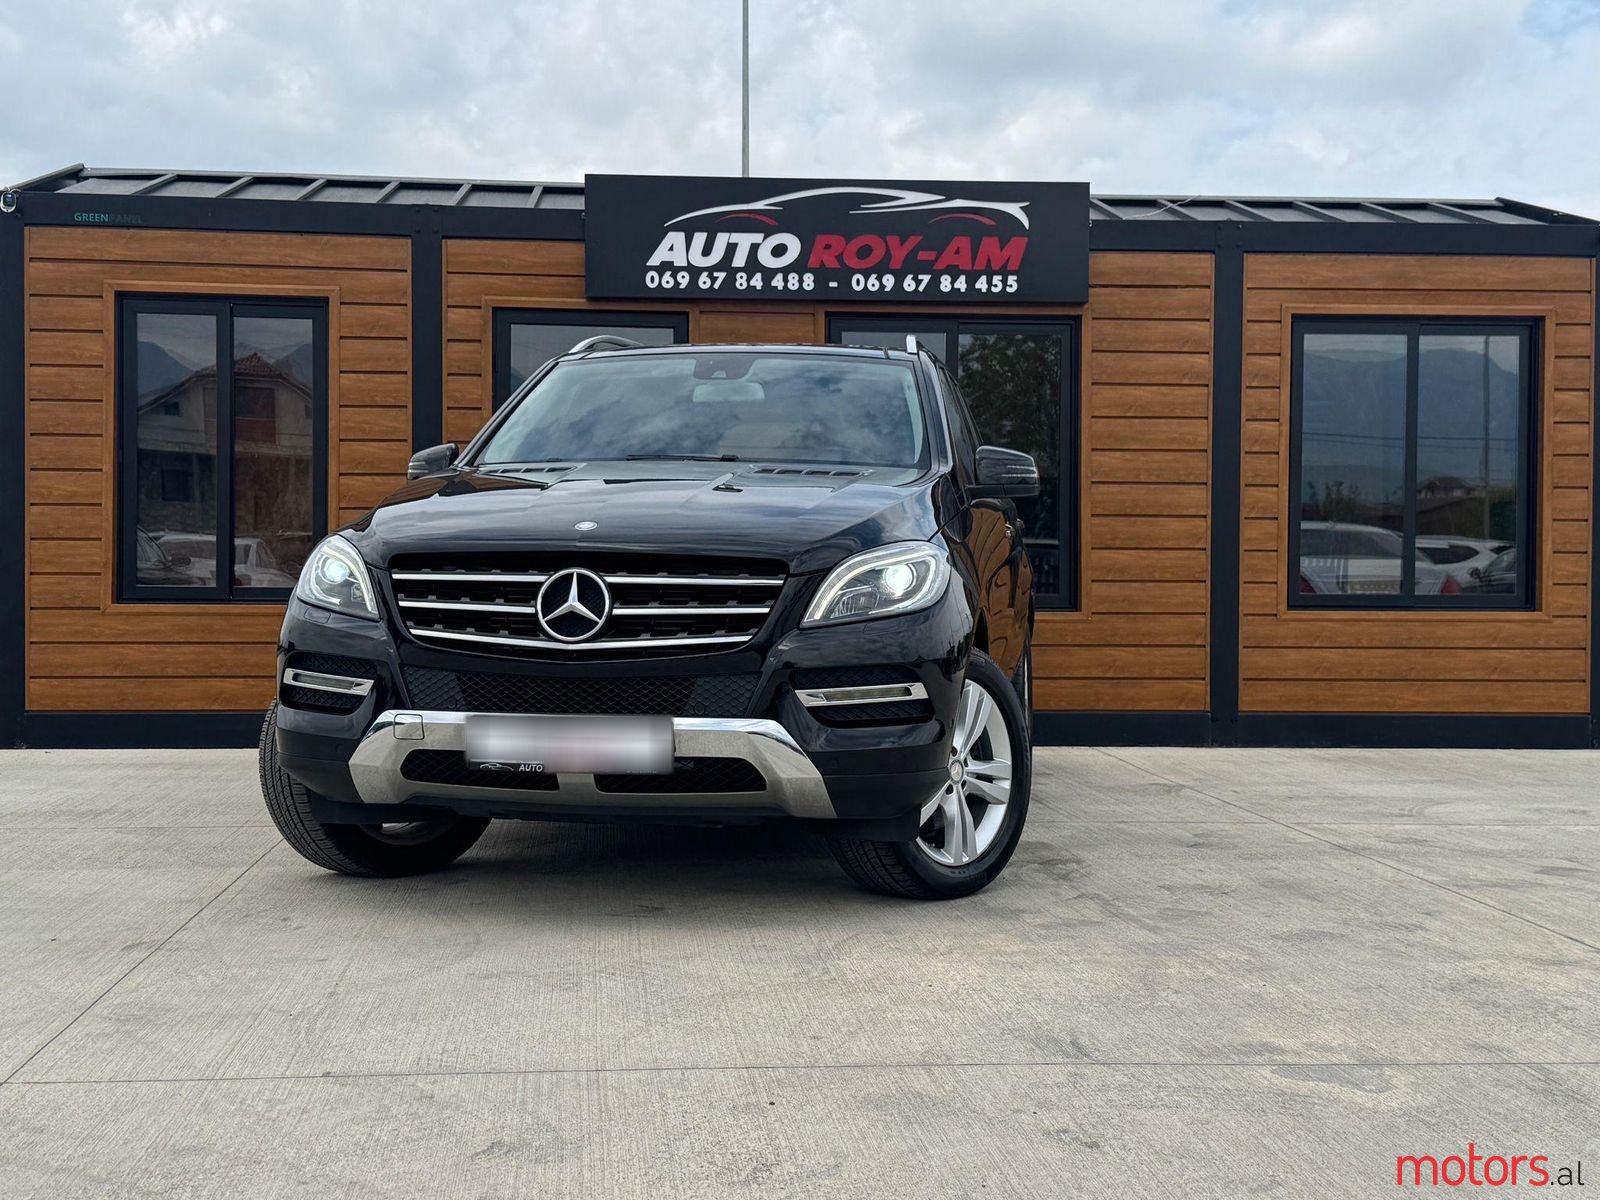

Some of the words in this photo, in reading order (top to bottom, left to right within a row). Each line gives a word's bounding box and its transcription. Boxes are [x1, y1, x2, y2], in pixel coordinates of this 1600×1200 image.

[646, 231, 802, 269] AUTO
[807, 234, 1029, 270] ROY-AM
[645, 270, 690, 289] 069
[698, 271, 727, 290] 67
[735, 272, 763, 290] 84
[771, 272, 815, 291] 488
[851, 272, 895, 292] 069
[903, 274, 932, 293] 67
[939, 274, 967, 293] 84
[974, 275, 1018, 293] 455
[518, 764, 543, 772] AUTO
